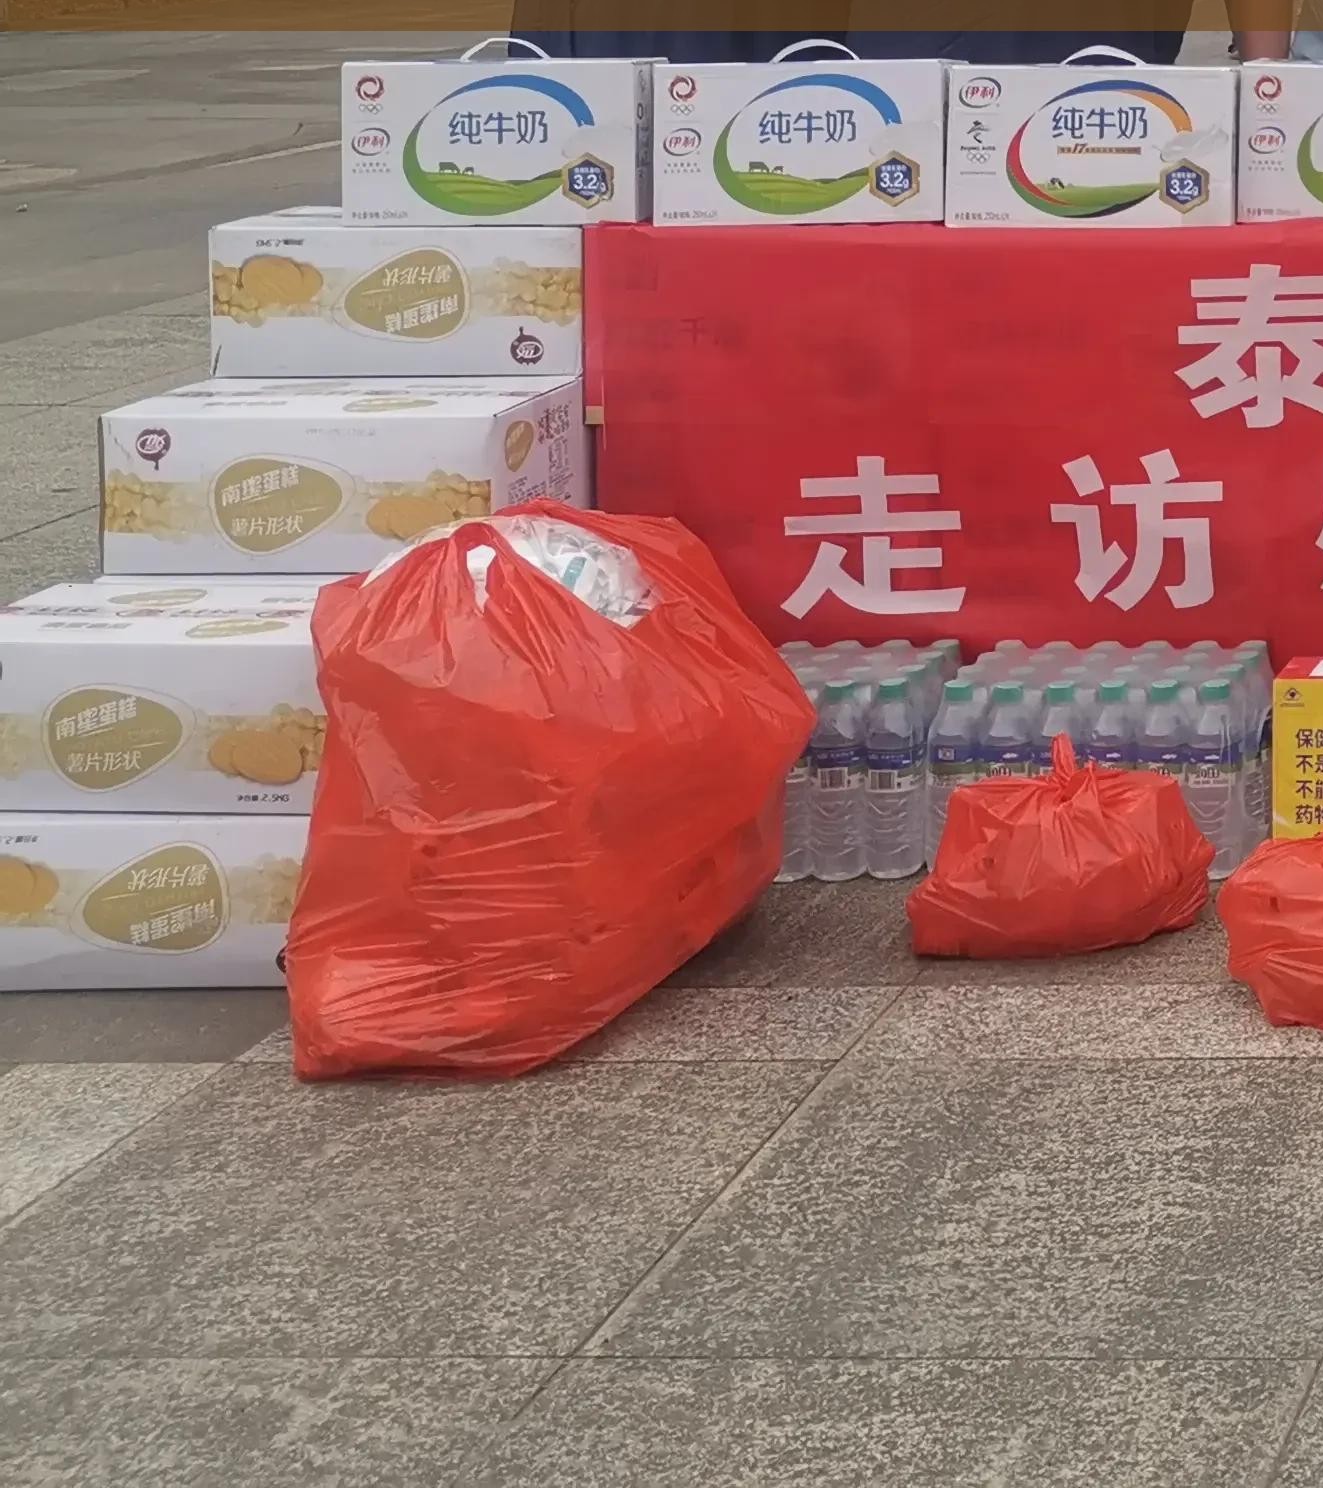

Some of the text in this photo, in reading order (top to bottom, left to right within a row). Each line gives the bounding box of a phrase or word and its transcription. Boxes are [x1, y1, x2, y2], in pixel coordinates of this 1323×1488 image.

[965, 84, 995, 100] 伊利
[448, 110, 549, 145] 纯牛奶
[758, 109, 856, 144] 纯牛奶
[1052, 106, 1148, 140] 纯牛奶
[357, 134, 385, 149] 伊利
[668, 135, 696, 148] 伊利
[1253, 134, 1280, 147] 伊利
[573, 174, 606, 193] 3.2g
[879, 171, 909, 190] 3.2g
[1170, 178, 1199, 197] 3.2g
